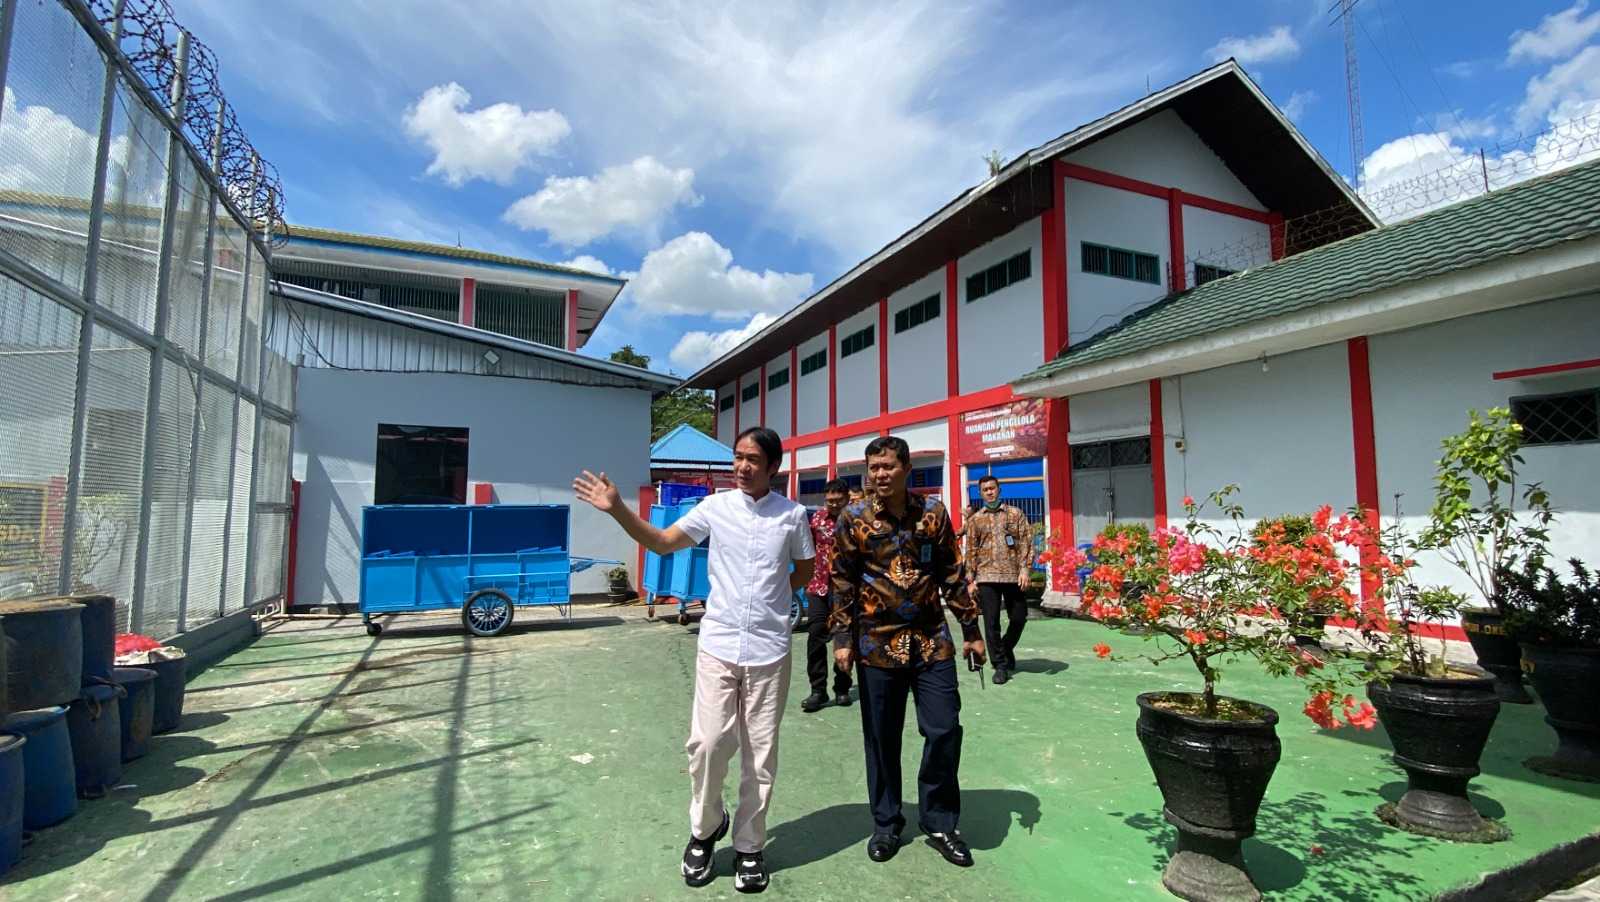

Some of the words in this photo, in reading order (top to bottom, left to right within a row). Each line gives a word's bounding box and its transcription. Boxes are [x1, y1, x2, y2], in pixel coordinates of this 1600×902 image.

[966, 421, 995, 434] RUANGAN
[996, 414, 1035, 427] PENGELOLA
[982, 430, 1015, 443] MAKANAN
